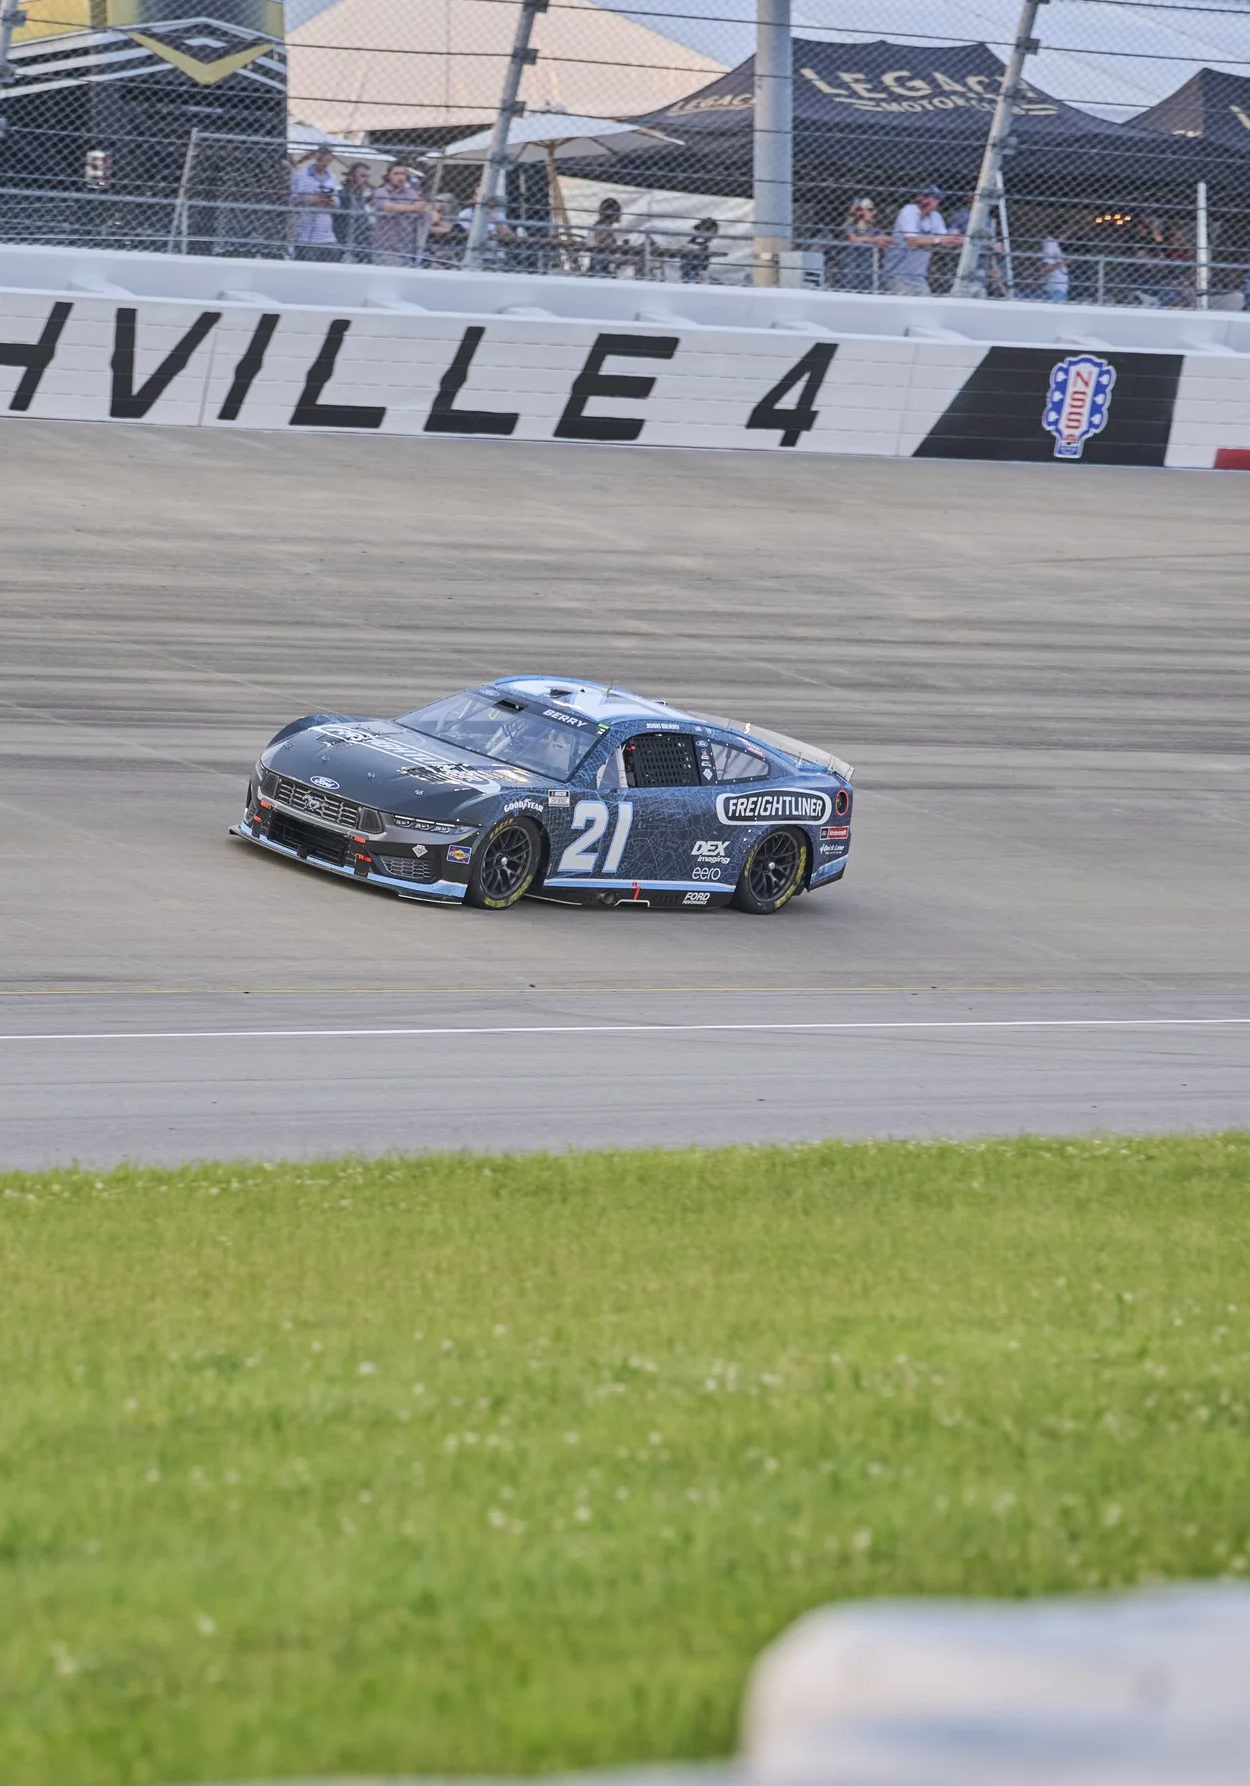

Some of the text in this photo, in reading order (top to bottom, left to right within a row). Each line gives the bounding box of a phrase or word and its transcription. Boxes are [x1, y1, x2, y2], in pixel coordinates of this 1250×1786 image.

[668, 93, 755, 112] LEGAC
[879, 95, 969, 112] MOTOR
[745, 342, 838, 447] 4
[1065, 370, 1093, 429] NSS
[542, 708, 589, 728] BERRY
[504, 799, 544, 813] GOODYEAR
[728, 795, 823, 817] FREIGHTLINER
[557, 800, 634, 873] 21
[691, 841, 730, 856] DEX
[692, 867, 721, 880] eero
[684, 892, 711, 901] FORD
